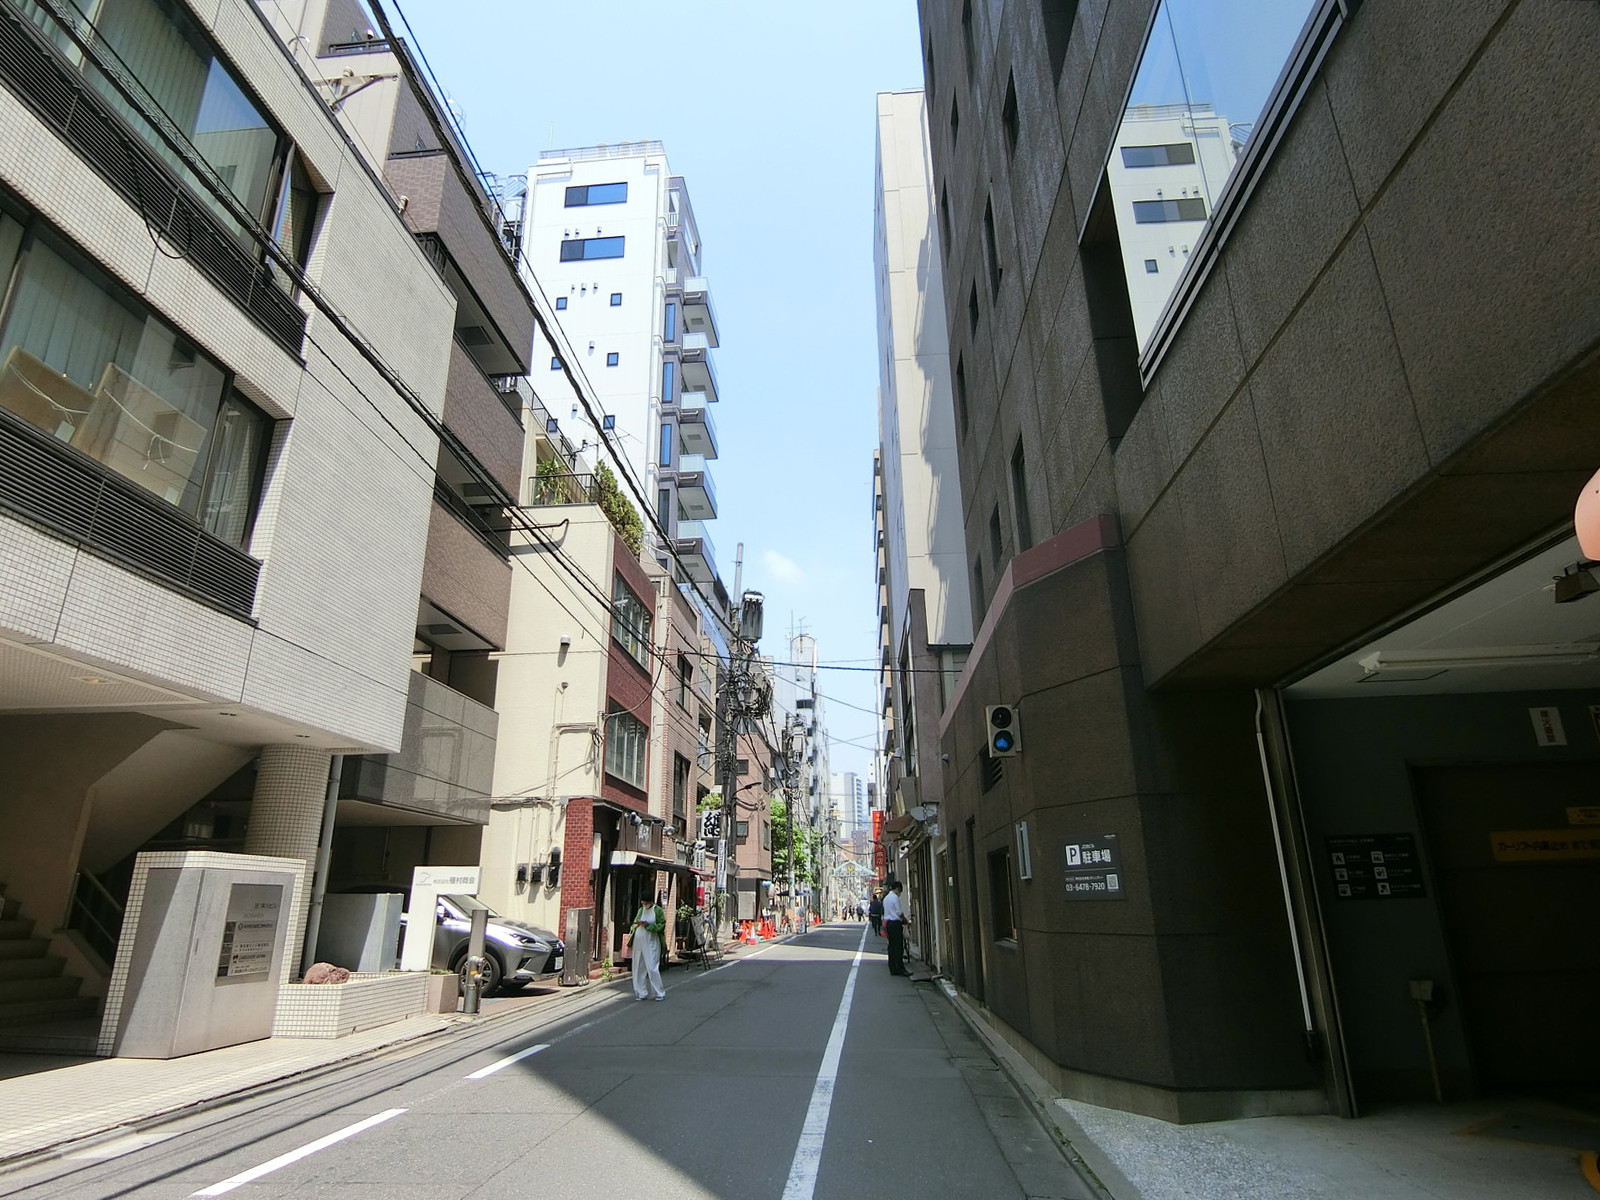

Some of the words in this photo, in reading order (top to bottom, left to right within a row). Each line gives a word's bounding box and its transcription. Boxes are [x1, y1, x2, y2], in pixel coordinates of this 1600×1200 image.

[1082, 849, 1111, 864] 駐車場
[1065, 882, 1106, 892] 03-6478-7920
